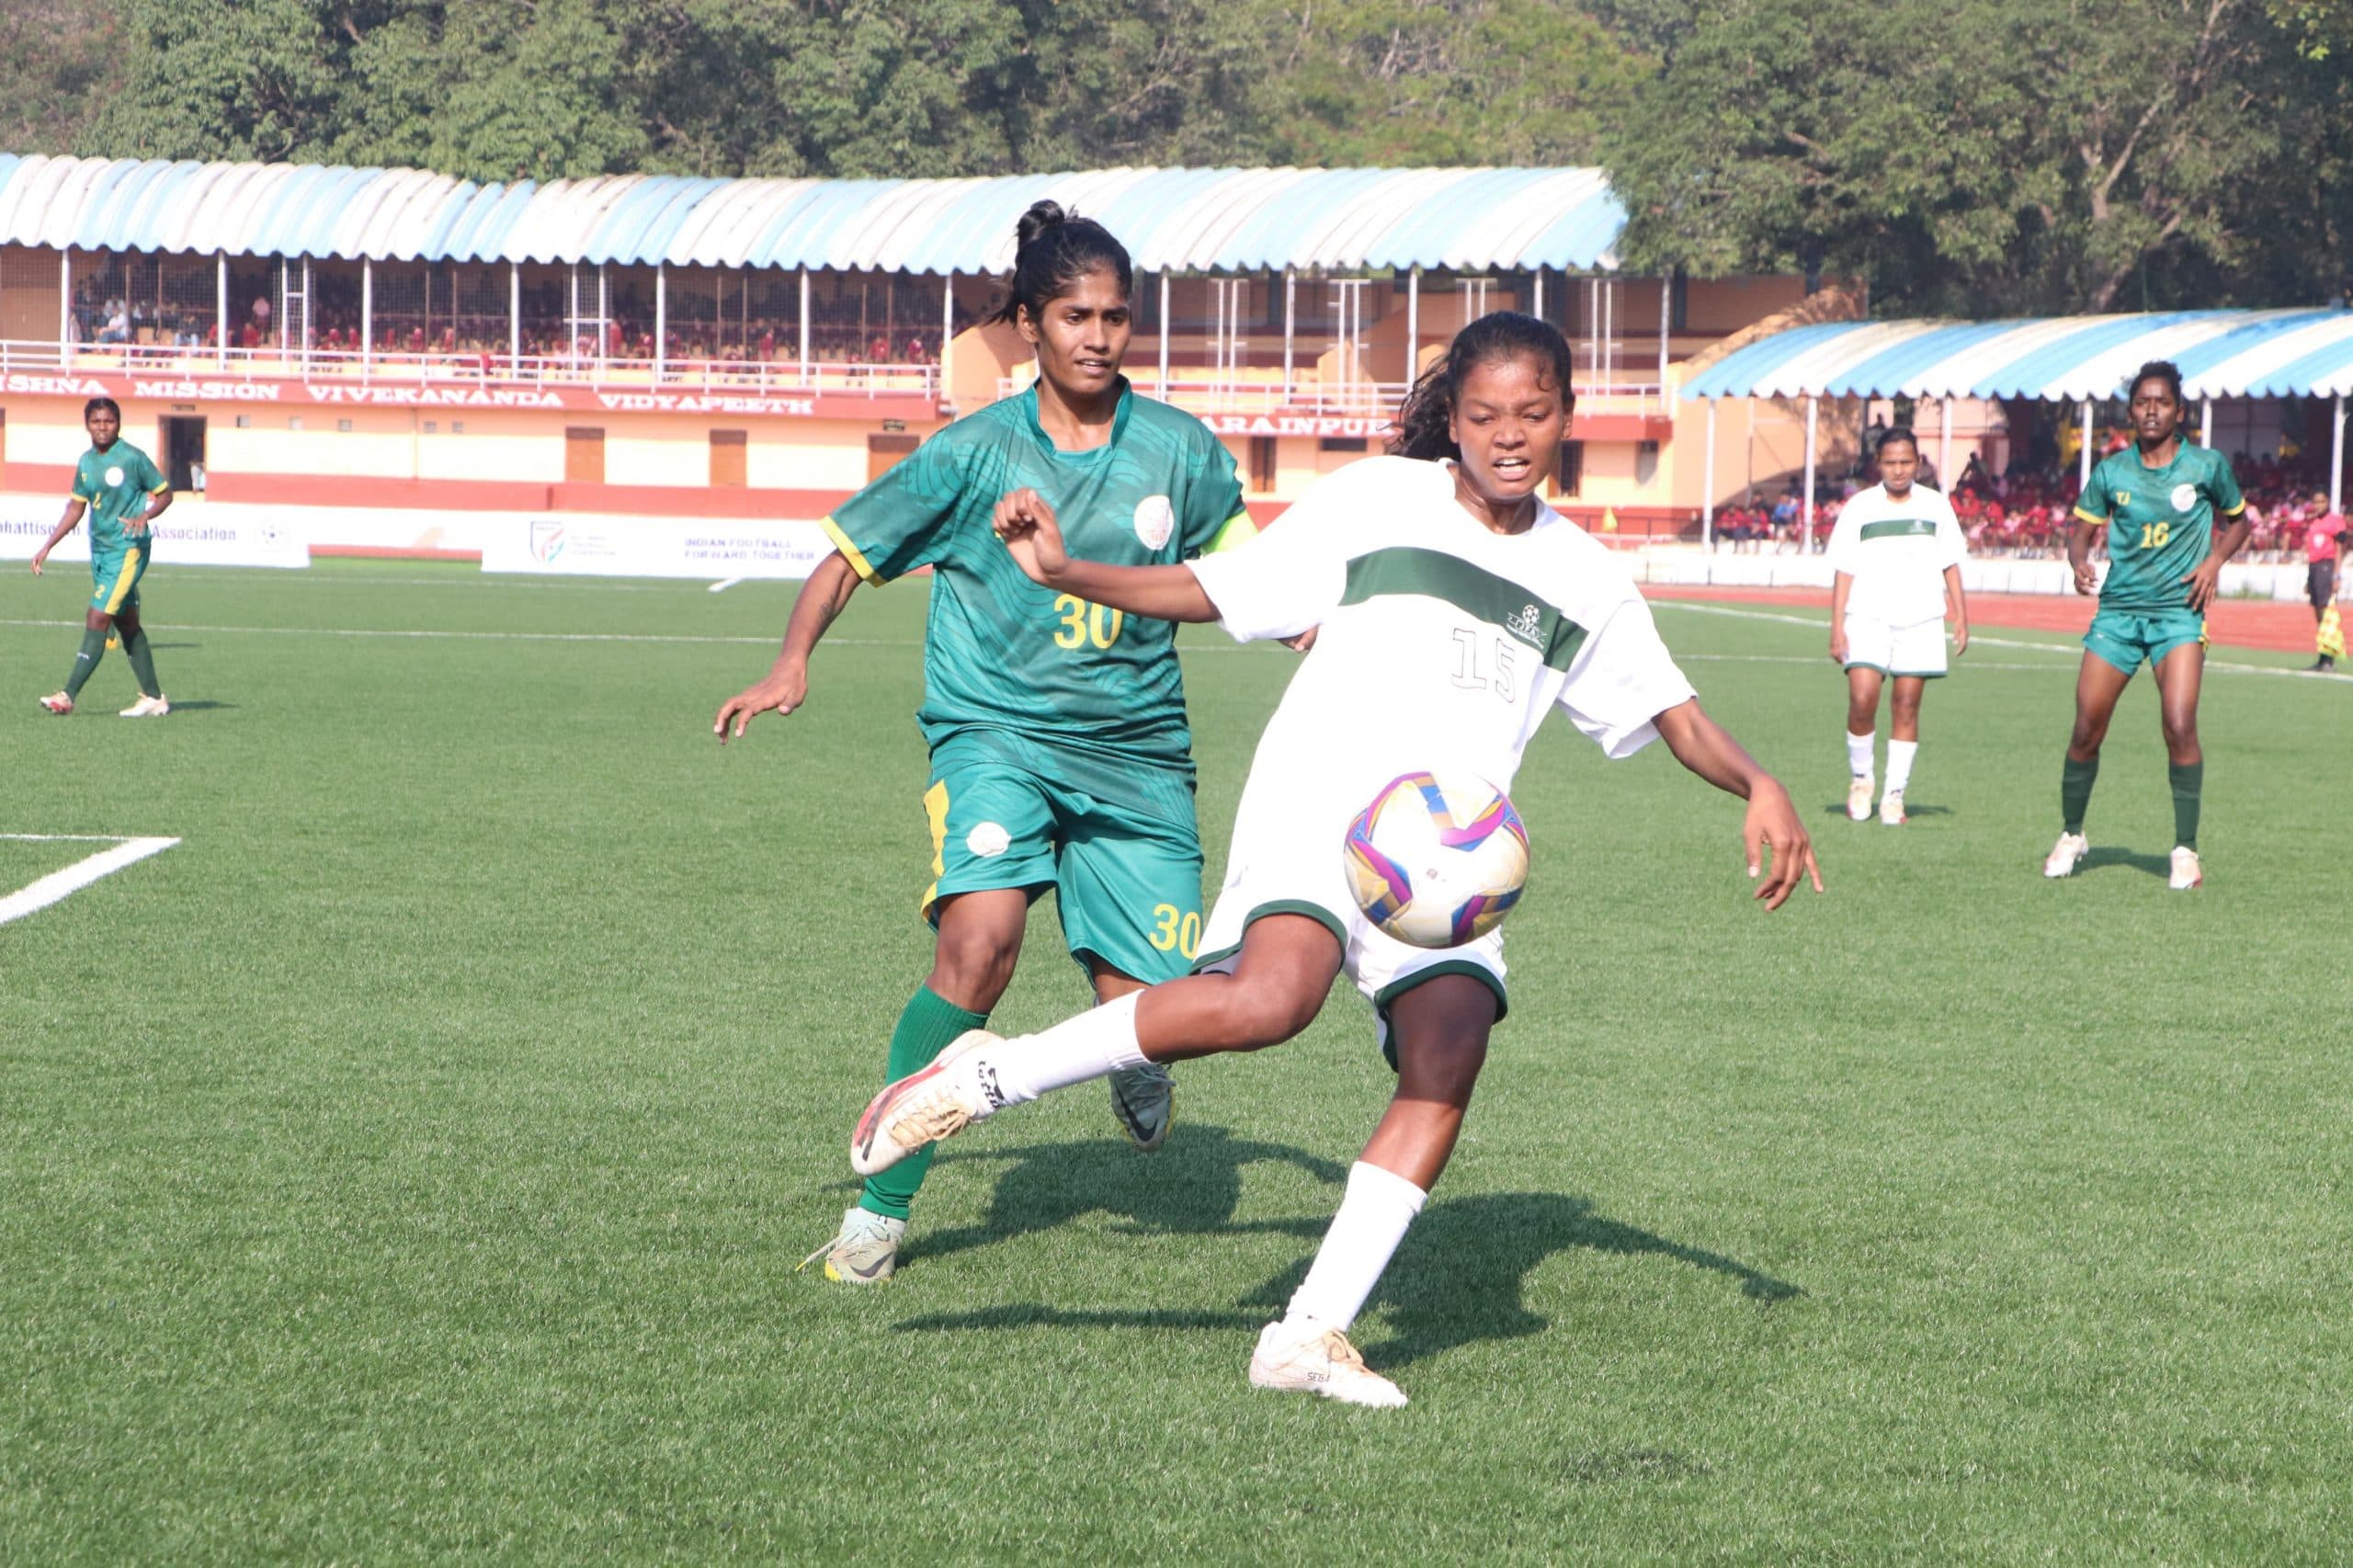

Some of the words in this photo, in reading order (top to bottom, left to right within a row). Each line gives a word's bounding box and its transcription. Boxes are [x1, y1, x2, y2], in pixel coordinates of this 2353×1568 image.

[133, 381, 280, 400] MISSION
[306, 385, 564, 406] VIVEKANANDA
[598, 393, 814, 414] VIDYAPEETH
[153, 525, 236, 540] Association
[684, 537, 726, 548] INDIAN
[729, 538, 791, 549] FOOTBALL
[2140, 521, 2169, 549] 16
[1053, 593, 1123, 649] 30
[1451, 627, 1516, 704] 15
[1149, 903, 1200, 960] 30
